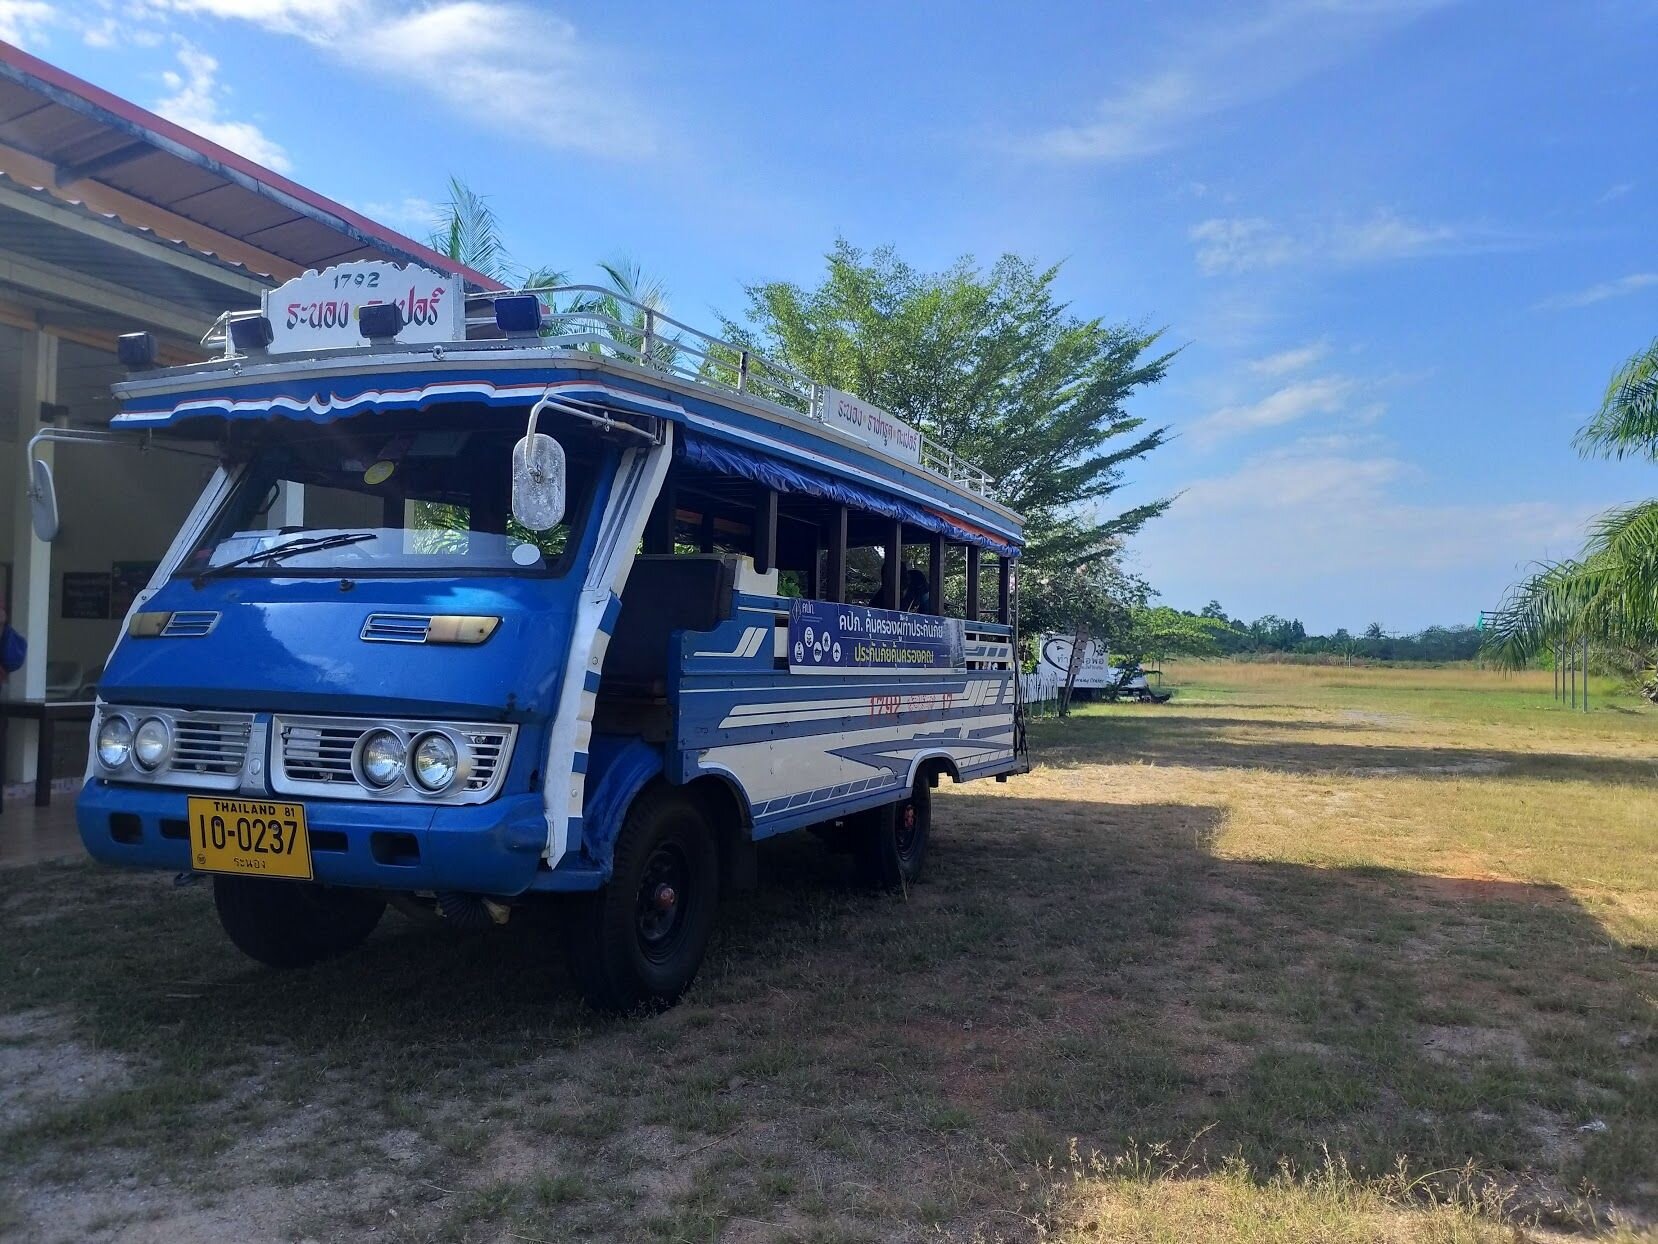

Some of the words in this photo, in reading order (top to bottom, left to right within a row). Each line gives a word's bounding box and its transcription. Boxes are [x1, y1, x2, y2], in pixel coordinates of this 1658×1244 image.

[333, 271, 381, 290] 1792
[286, 300, 349, 330] ระนอง
[838, 400, 863, 427] ระนอง
[839, 610, 863, 632] คปภ.
[865, 610, 944, 642] คุ้มครองผู้ทำประกันภัย
[854, 642, 935, 670] ประกันภัยคุ้มครองคุณ
[213, 801, 276, 816] THAILAND
[284, 807, 295, 818] 81
[200, 814, 298, 855] 10-0237
[233, 857, 266, 870] ระนอง
